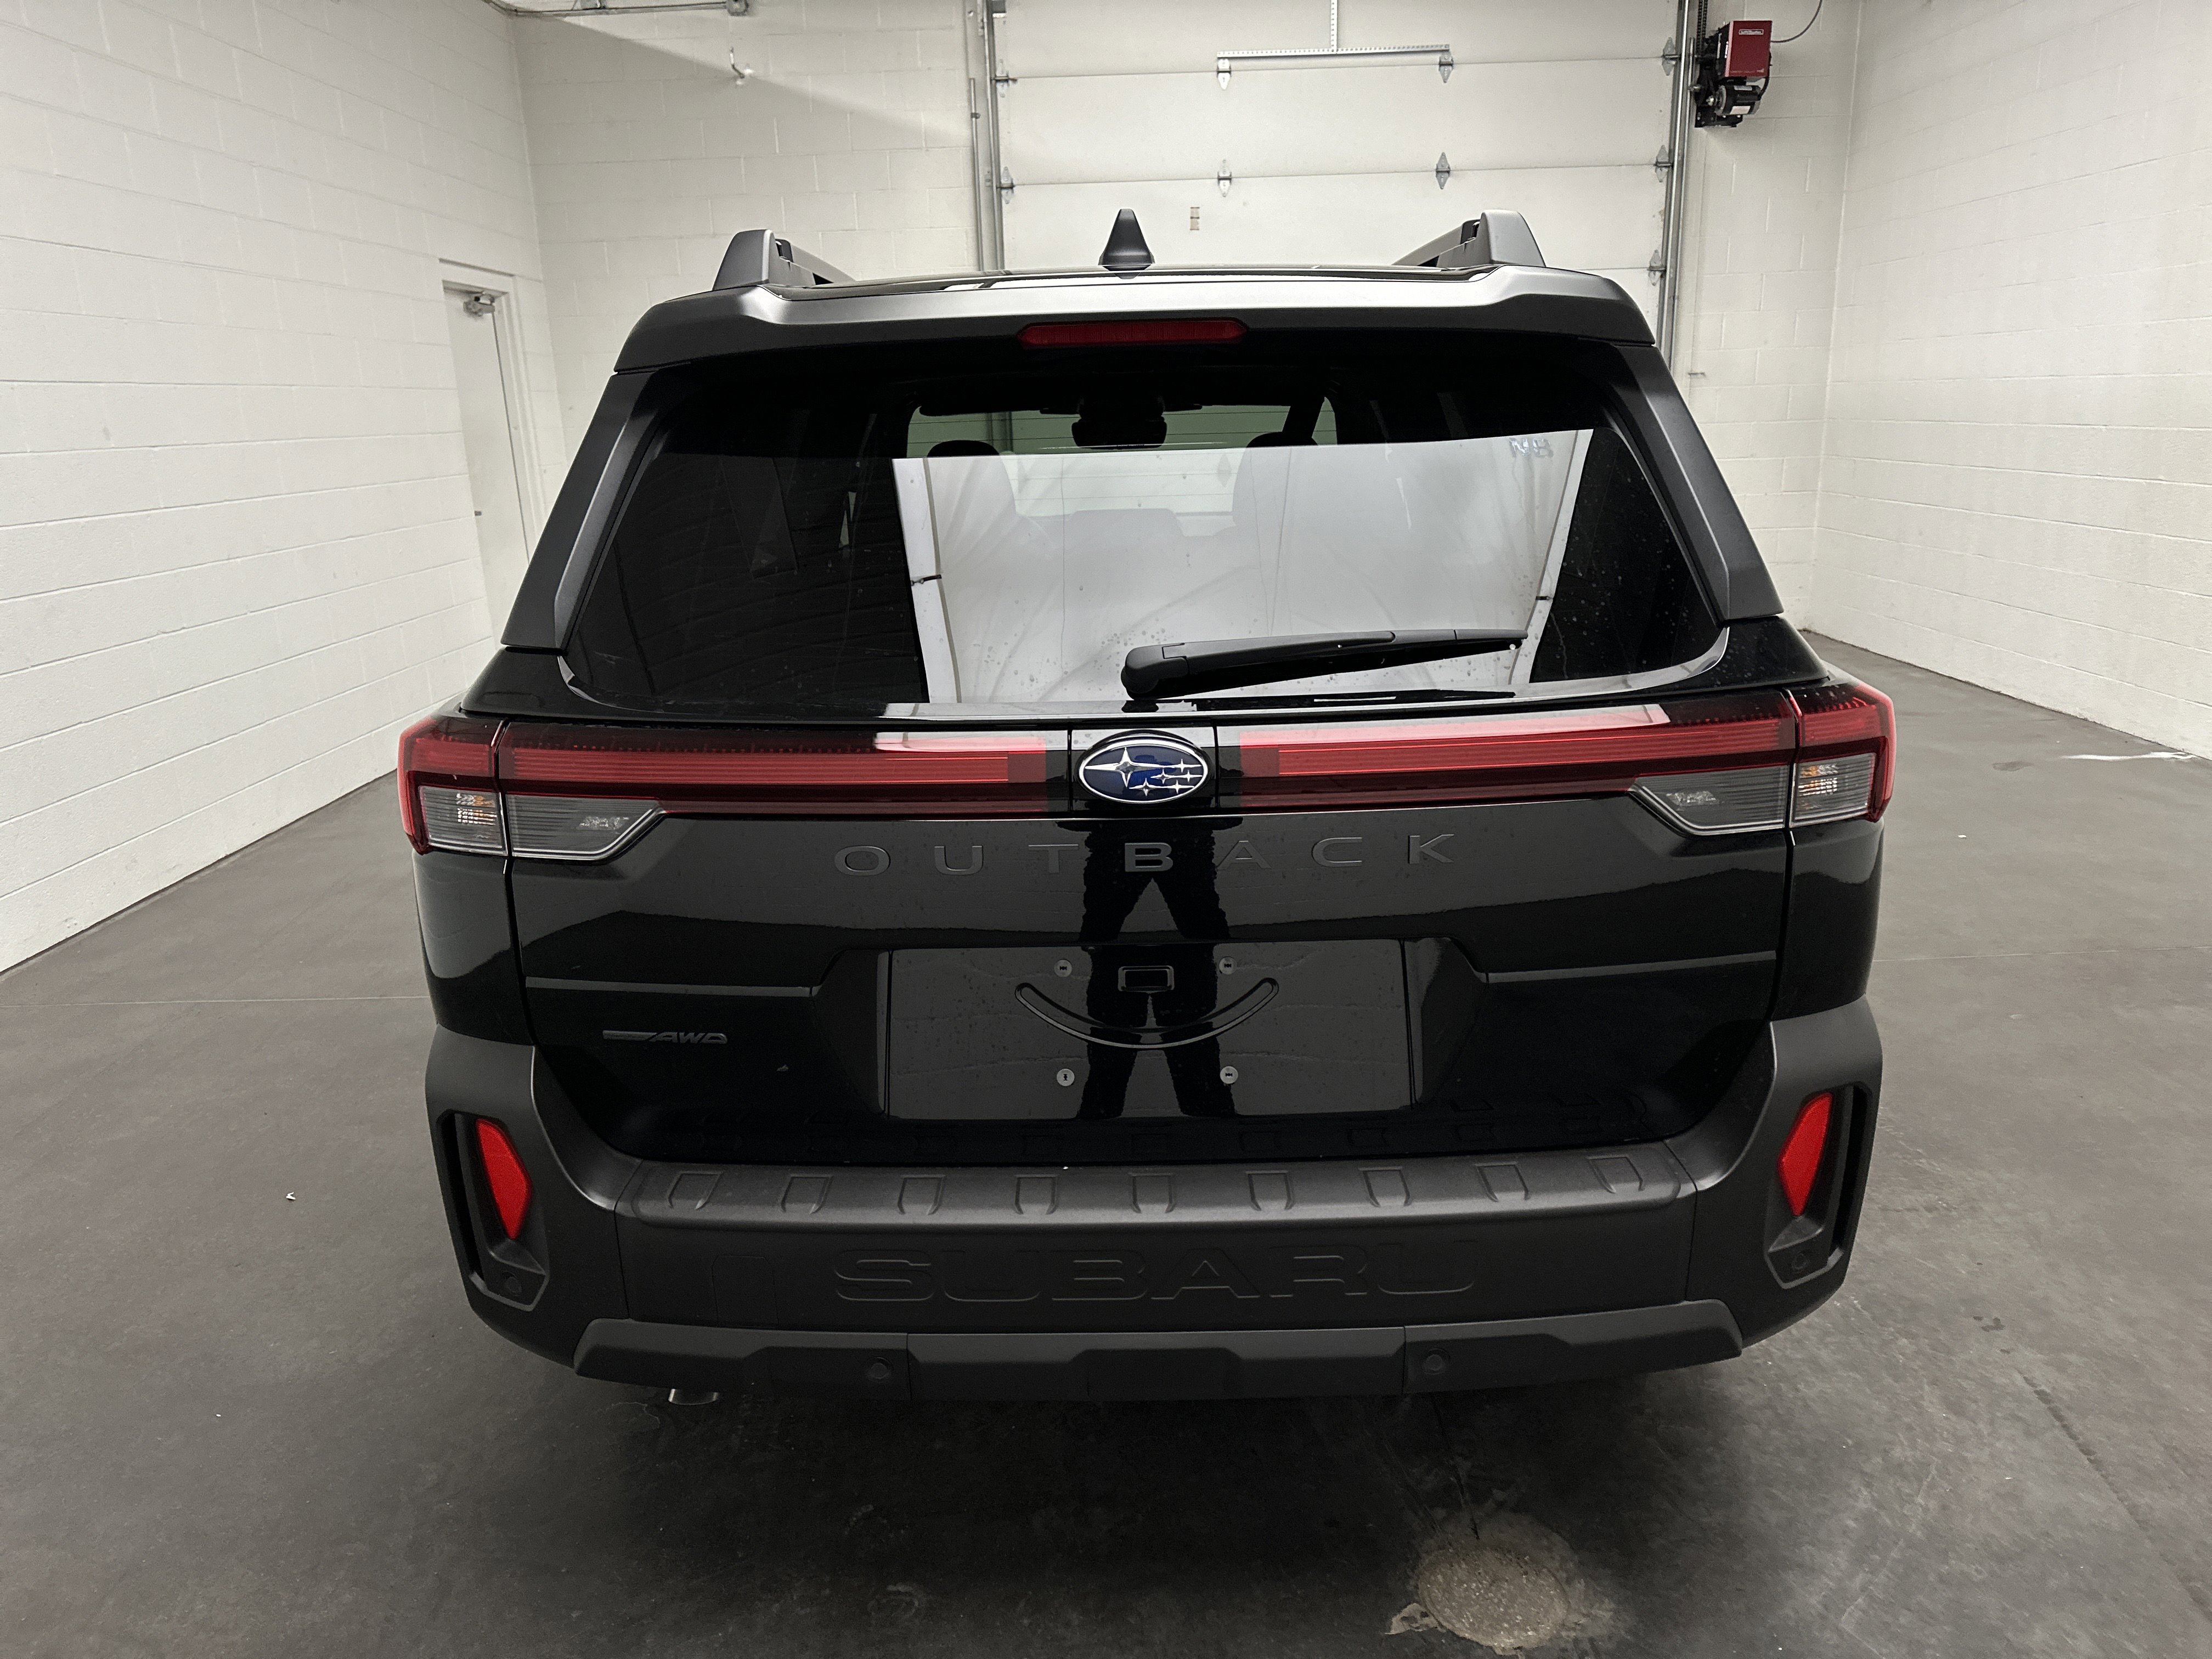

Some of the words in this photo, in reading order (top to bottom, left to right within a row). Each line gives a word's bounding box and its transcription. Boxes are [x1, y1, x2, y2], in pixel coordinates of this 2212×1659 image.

[834, 833, 1455, 876] OUTBACK
[648, 1031, 728, 1044] AWD
[833, 1239, 1477, 1302] SUBARU
